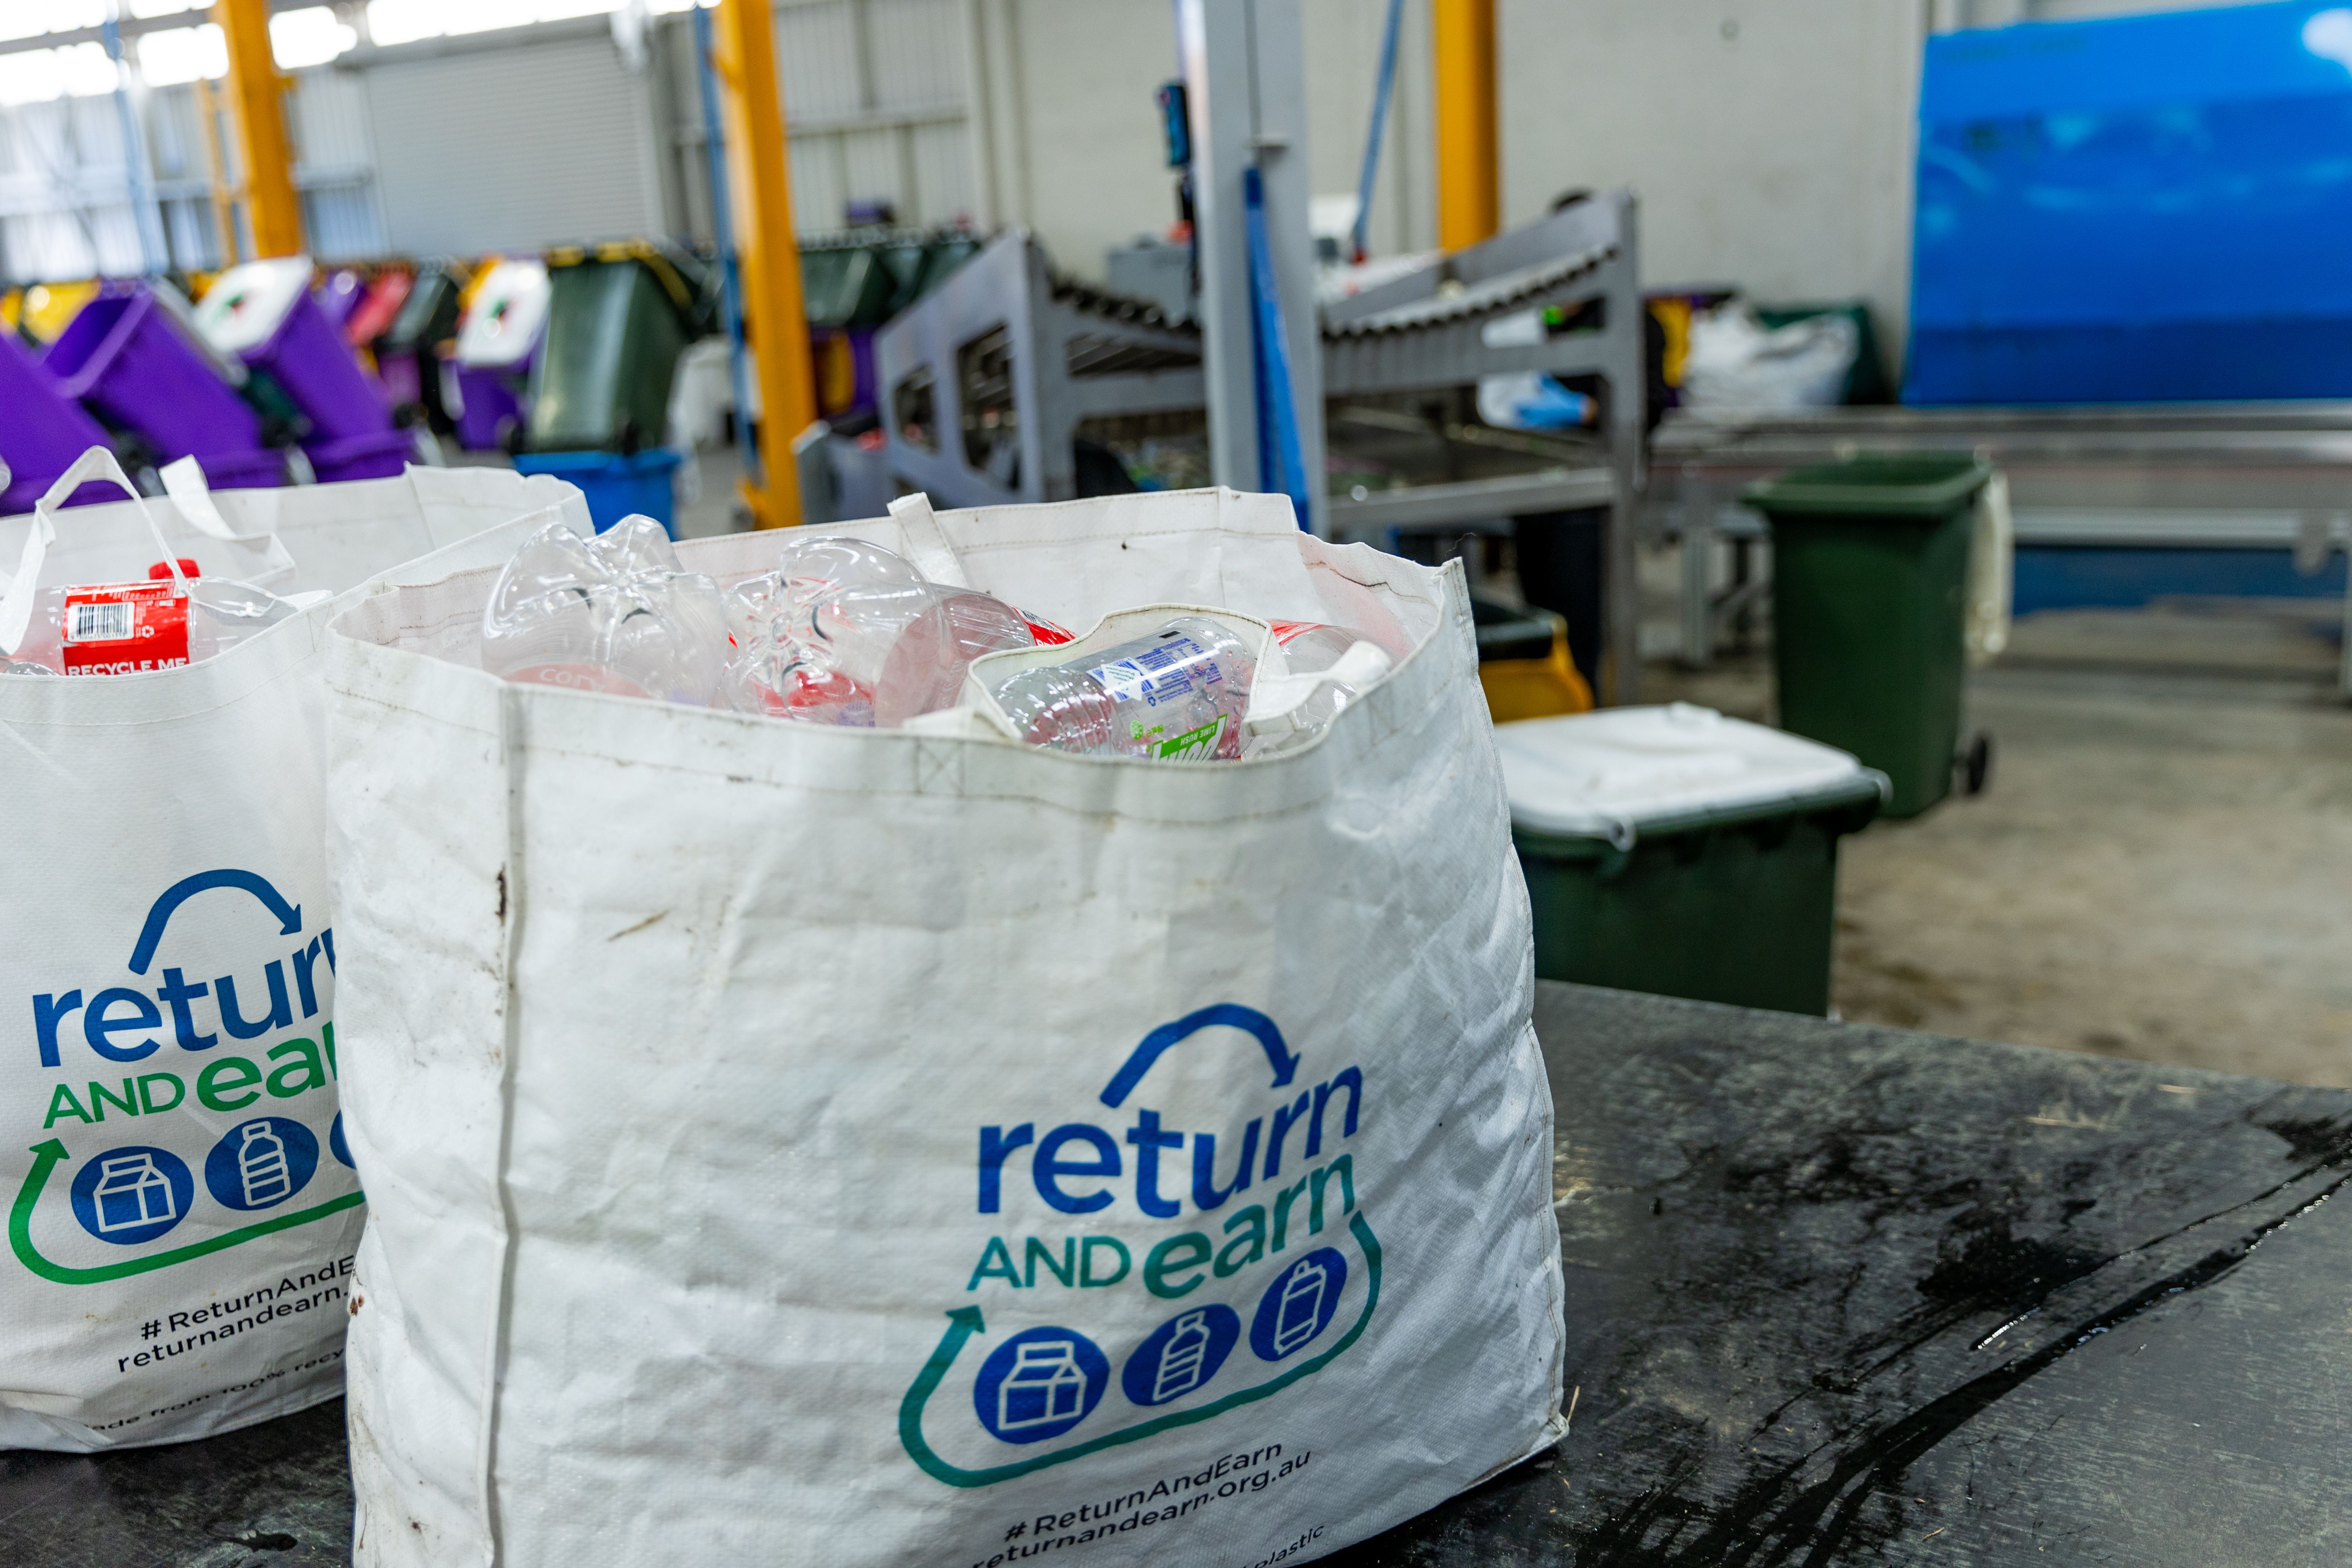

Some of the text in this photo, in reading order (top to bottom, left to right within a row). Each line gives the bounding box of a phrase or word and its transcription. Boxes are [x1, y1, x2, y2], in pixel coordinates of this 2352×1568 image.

[67, 657, 187, 676] RECYCLE ME
[1180, 725, 1215, 746] LIME RUSH
[43, 1071, 186, 1129] AND
[978, 1065, 1362, 1218] return
[966, 1153, 1356, 1299] AND earn
[83, 1417, 140, 1430] ade
[150, 1395, 210, 1417] from
[1004, 1443, 1283, 1542] #ReturnAndEarn
